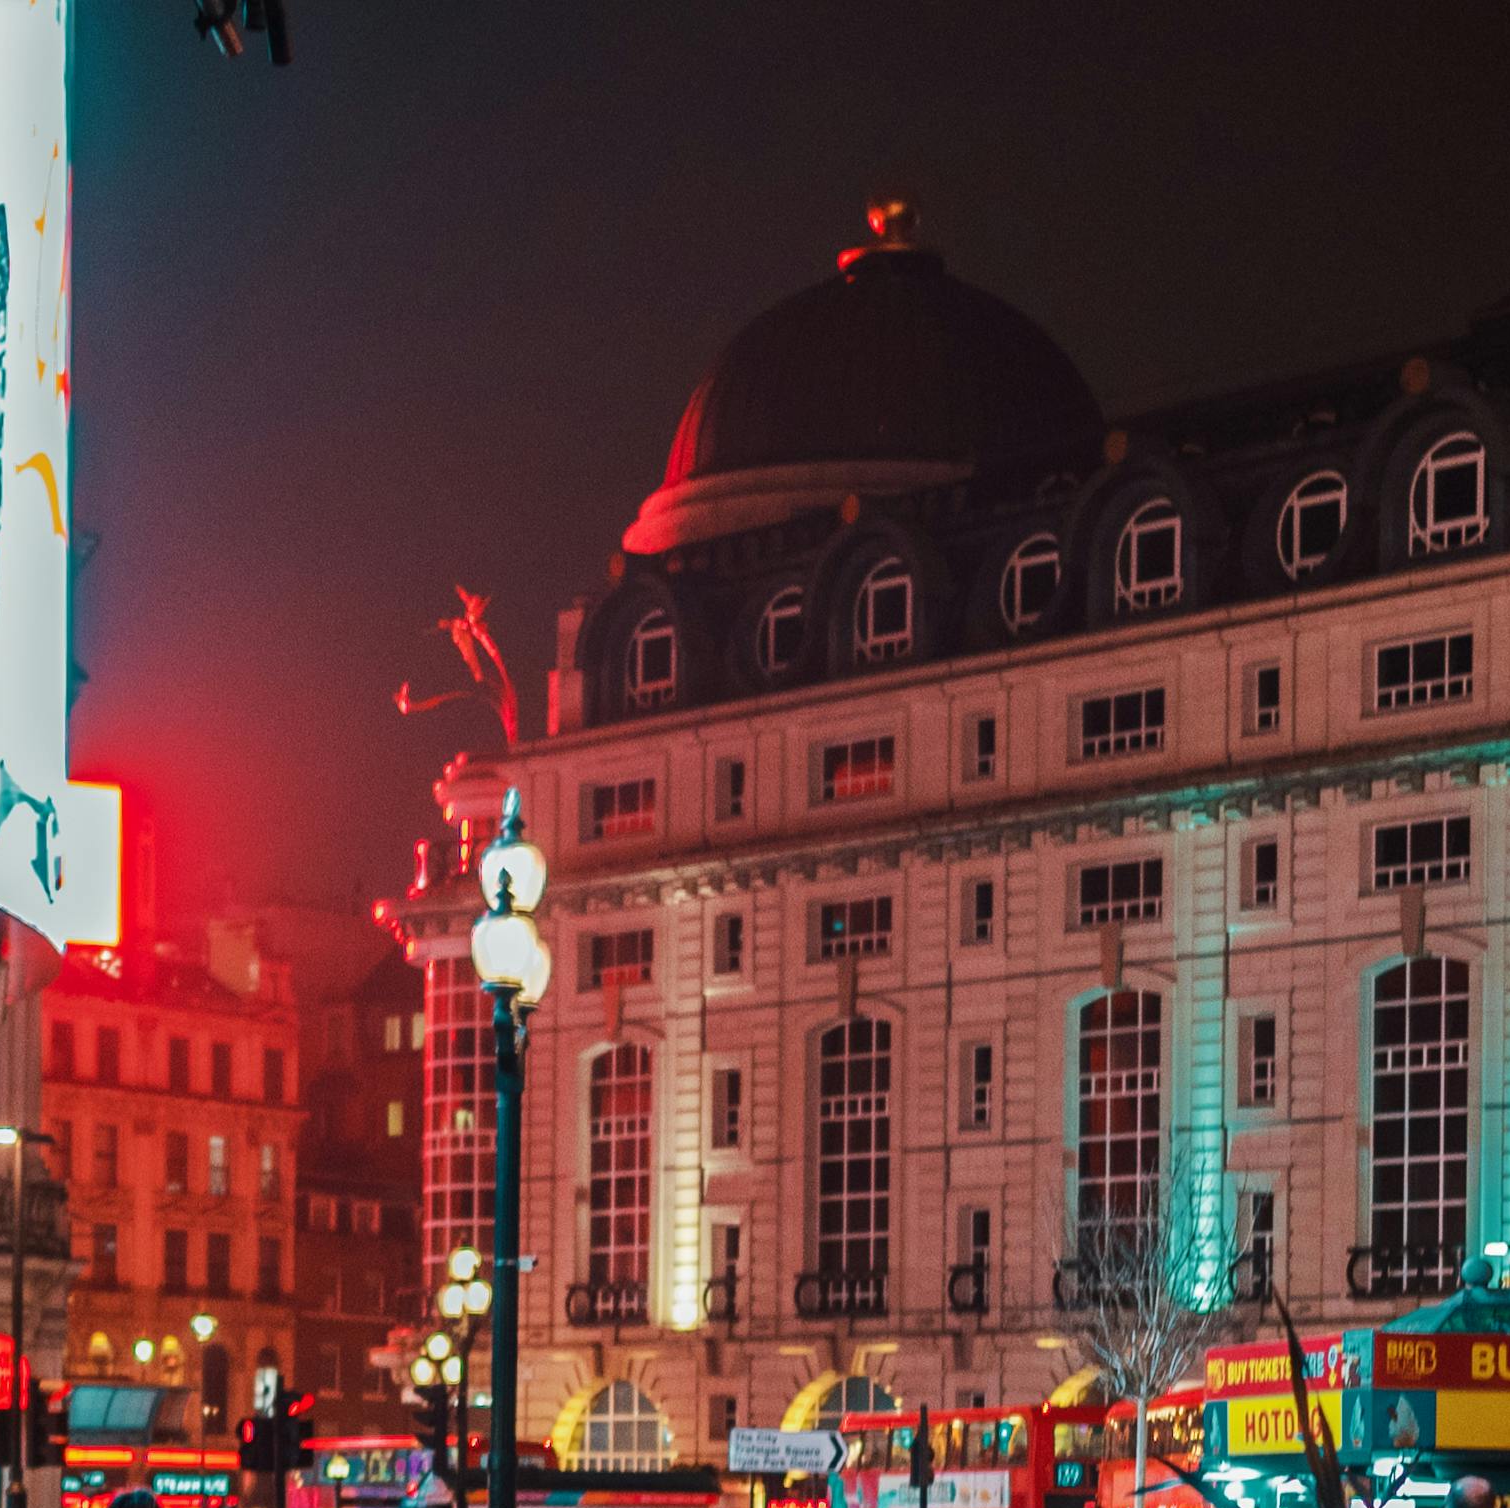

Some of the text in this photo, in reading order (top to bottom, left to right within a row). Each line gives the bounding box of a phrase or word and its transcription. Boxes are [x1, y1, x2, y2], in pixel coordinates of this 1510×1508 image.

[1227, 1360, 1248, 1386] BUY
[1248, 1355, 1293, 1385] TICKETS
[1244, 1407, 1324, 1445] HOTDG
